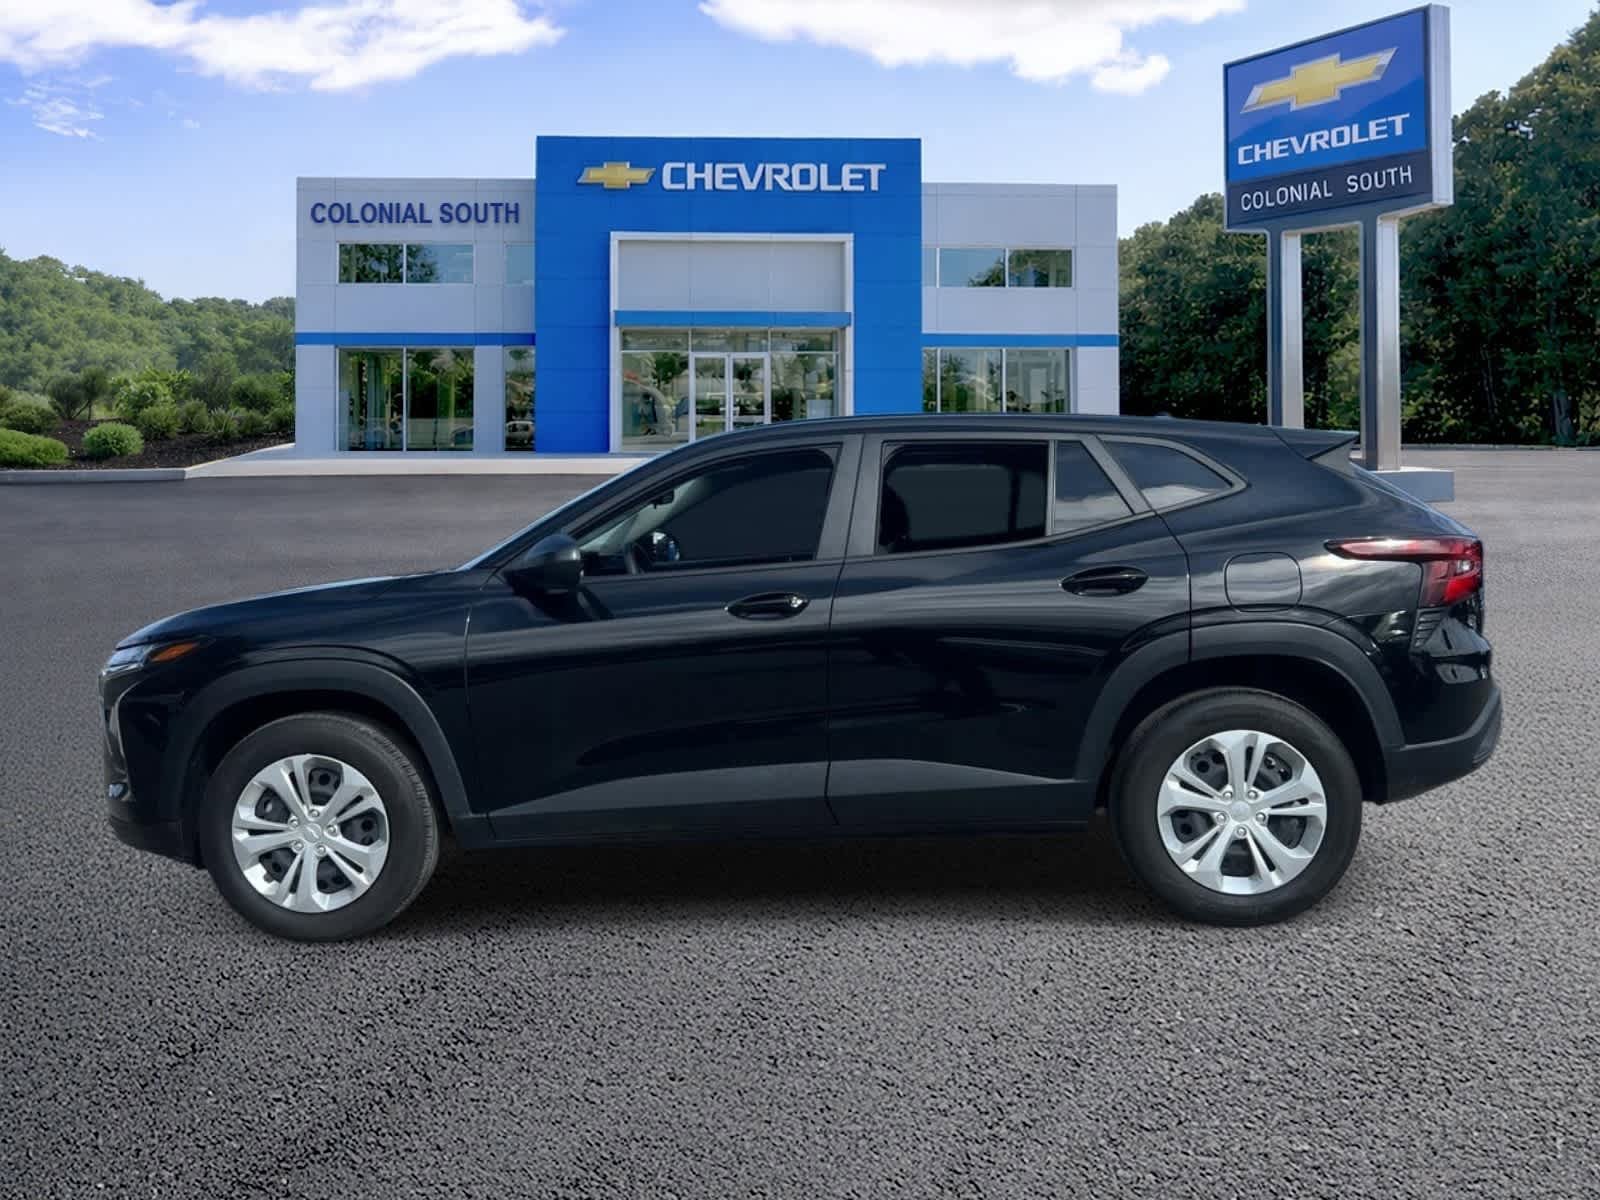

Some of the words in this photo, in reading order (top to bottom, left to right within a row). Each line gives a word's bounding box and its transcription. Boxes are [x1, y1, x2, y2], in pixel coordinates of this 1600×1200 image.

[1237, 113, 1410, 165] CHEVROLET
[661, 162, 887, 192] CHEVROLET
[1240, 180, 1333, 211] COLONIAL
[1346, 165, 1413, 193] SOUTH
[310, 202, 433, 225] COLONIAL
[438, 202, 521, 225] SOUTH
